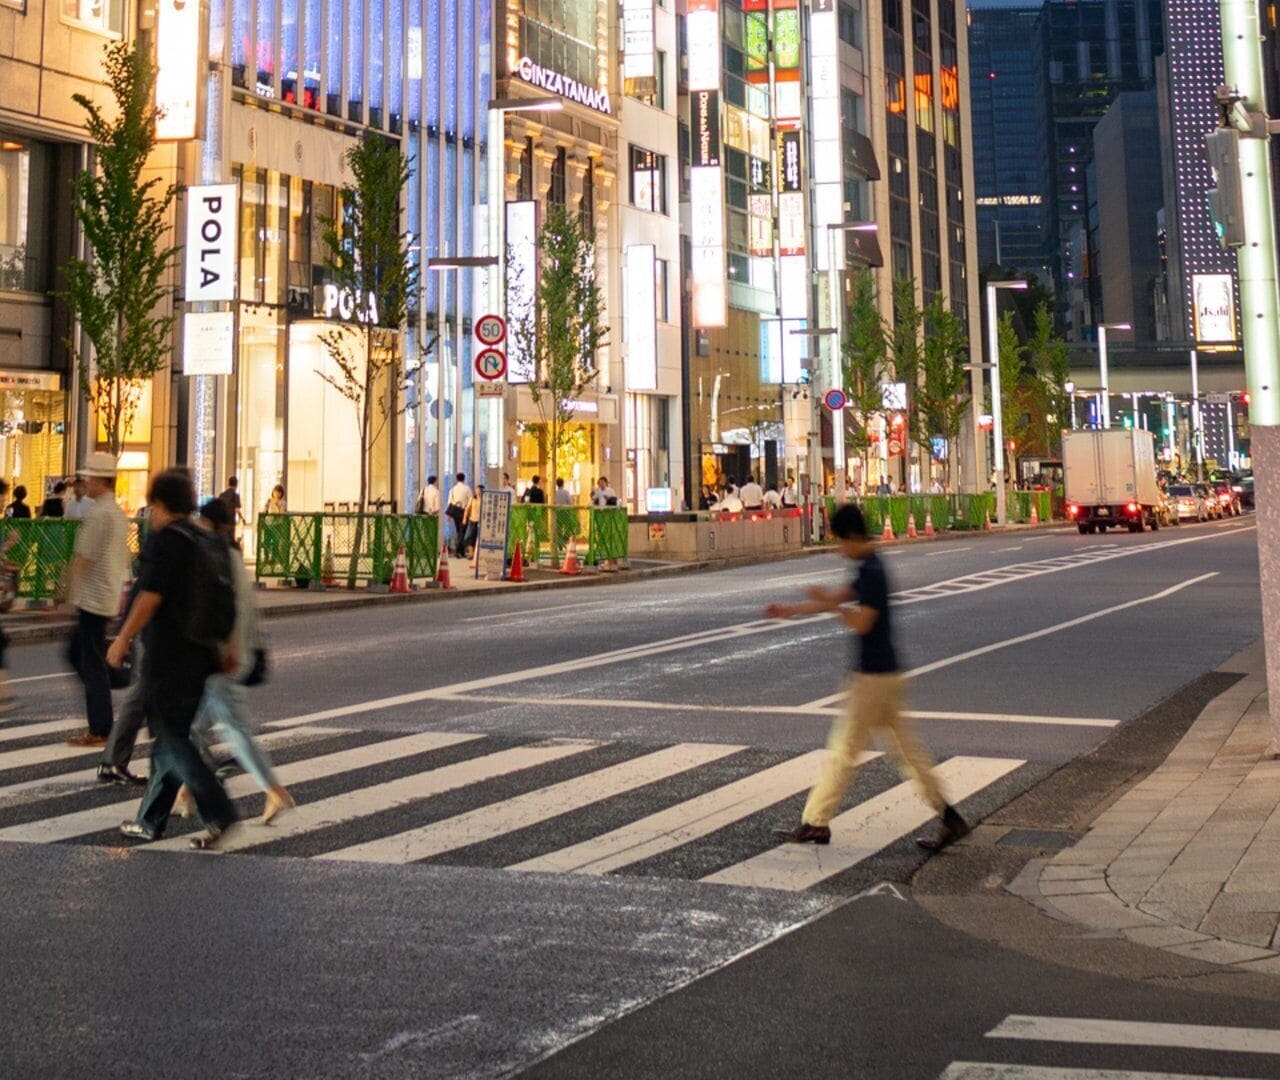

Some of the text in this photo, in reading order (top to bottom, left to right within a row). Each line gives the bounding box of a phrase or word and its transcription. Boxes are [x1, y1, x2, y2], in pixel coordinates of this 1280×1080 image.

[520, 56, 612, 114] GINZATANAKA
[200, 196, 222, 289] POLA
[325, 284, 379, 325] POLA
[482, 322, 500, 338] 50
